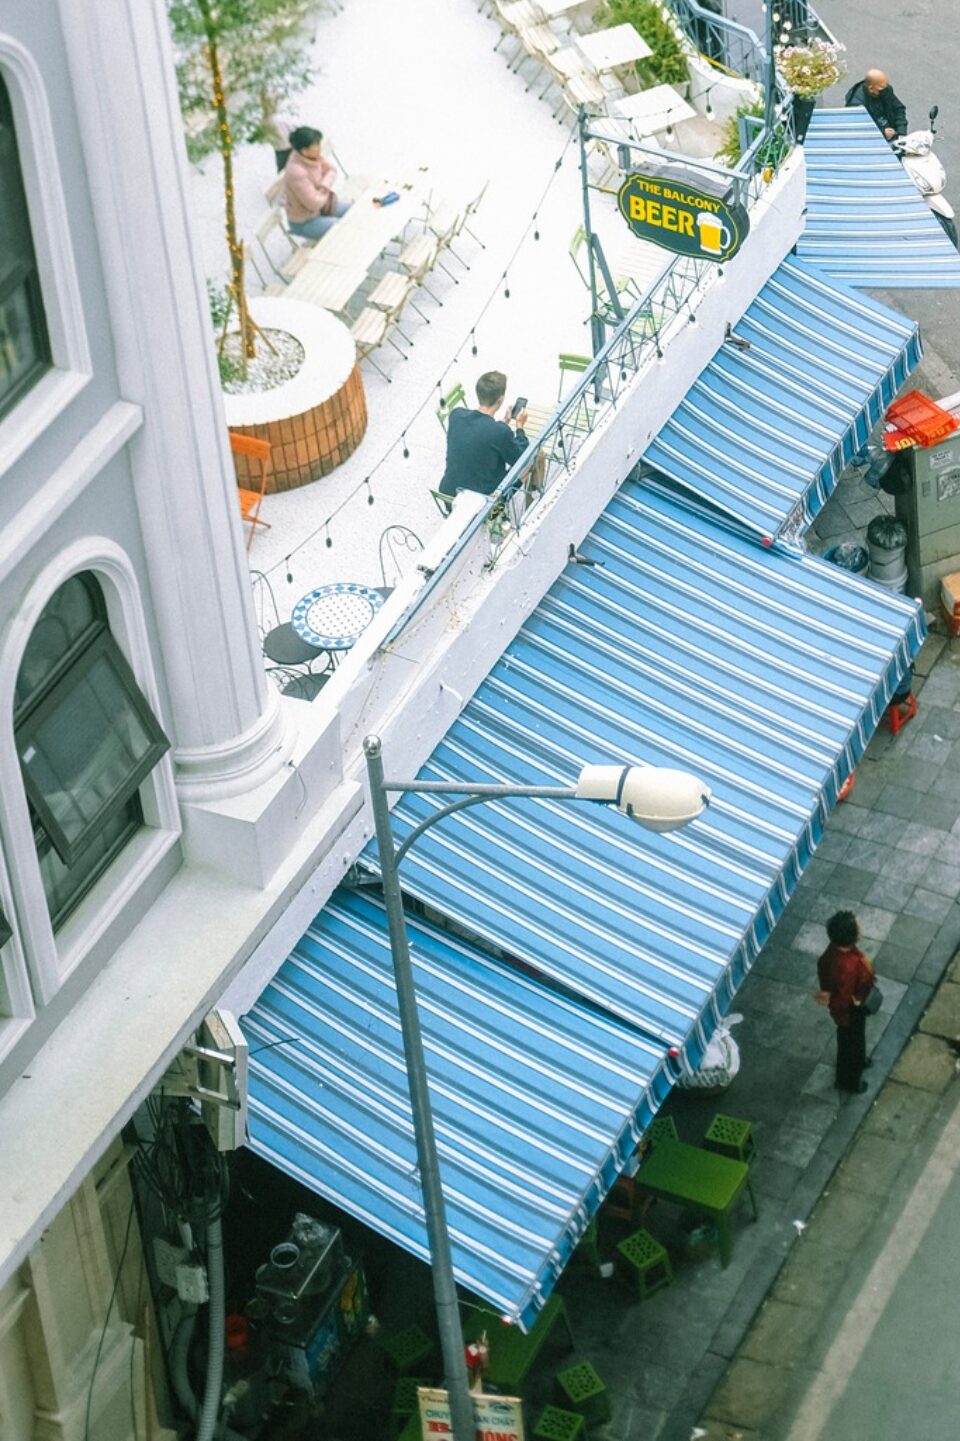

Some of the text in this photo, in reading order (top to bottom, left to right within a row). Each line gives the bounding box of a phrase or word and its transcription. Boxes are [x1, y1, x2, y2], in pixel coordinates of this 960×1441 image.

[629, 194, 696, 238] BEER
[637, 179, 721, 214] THE BALCONY
